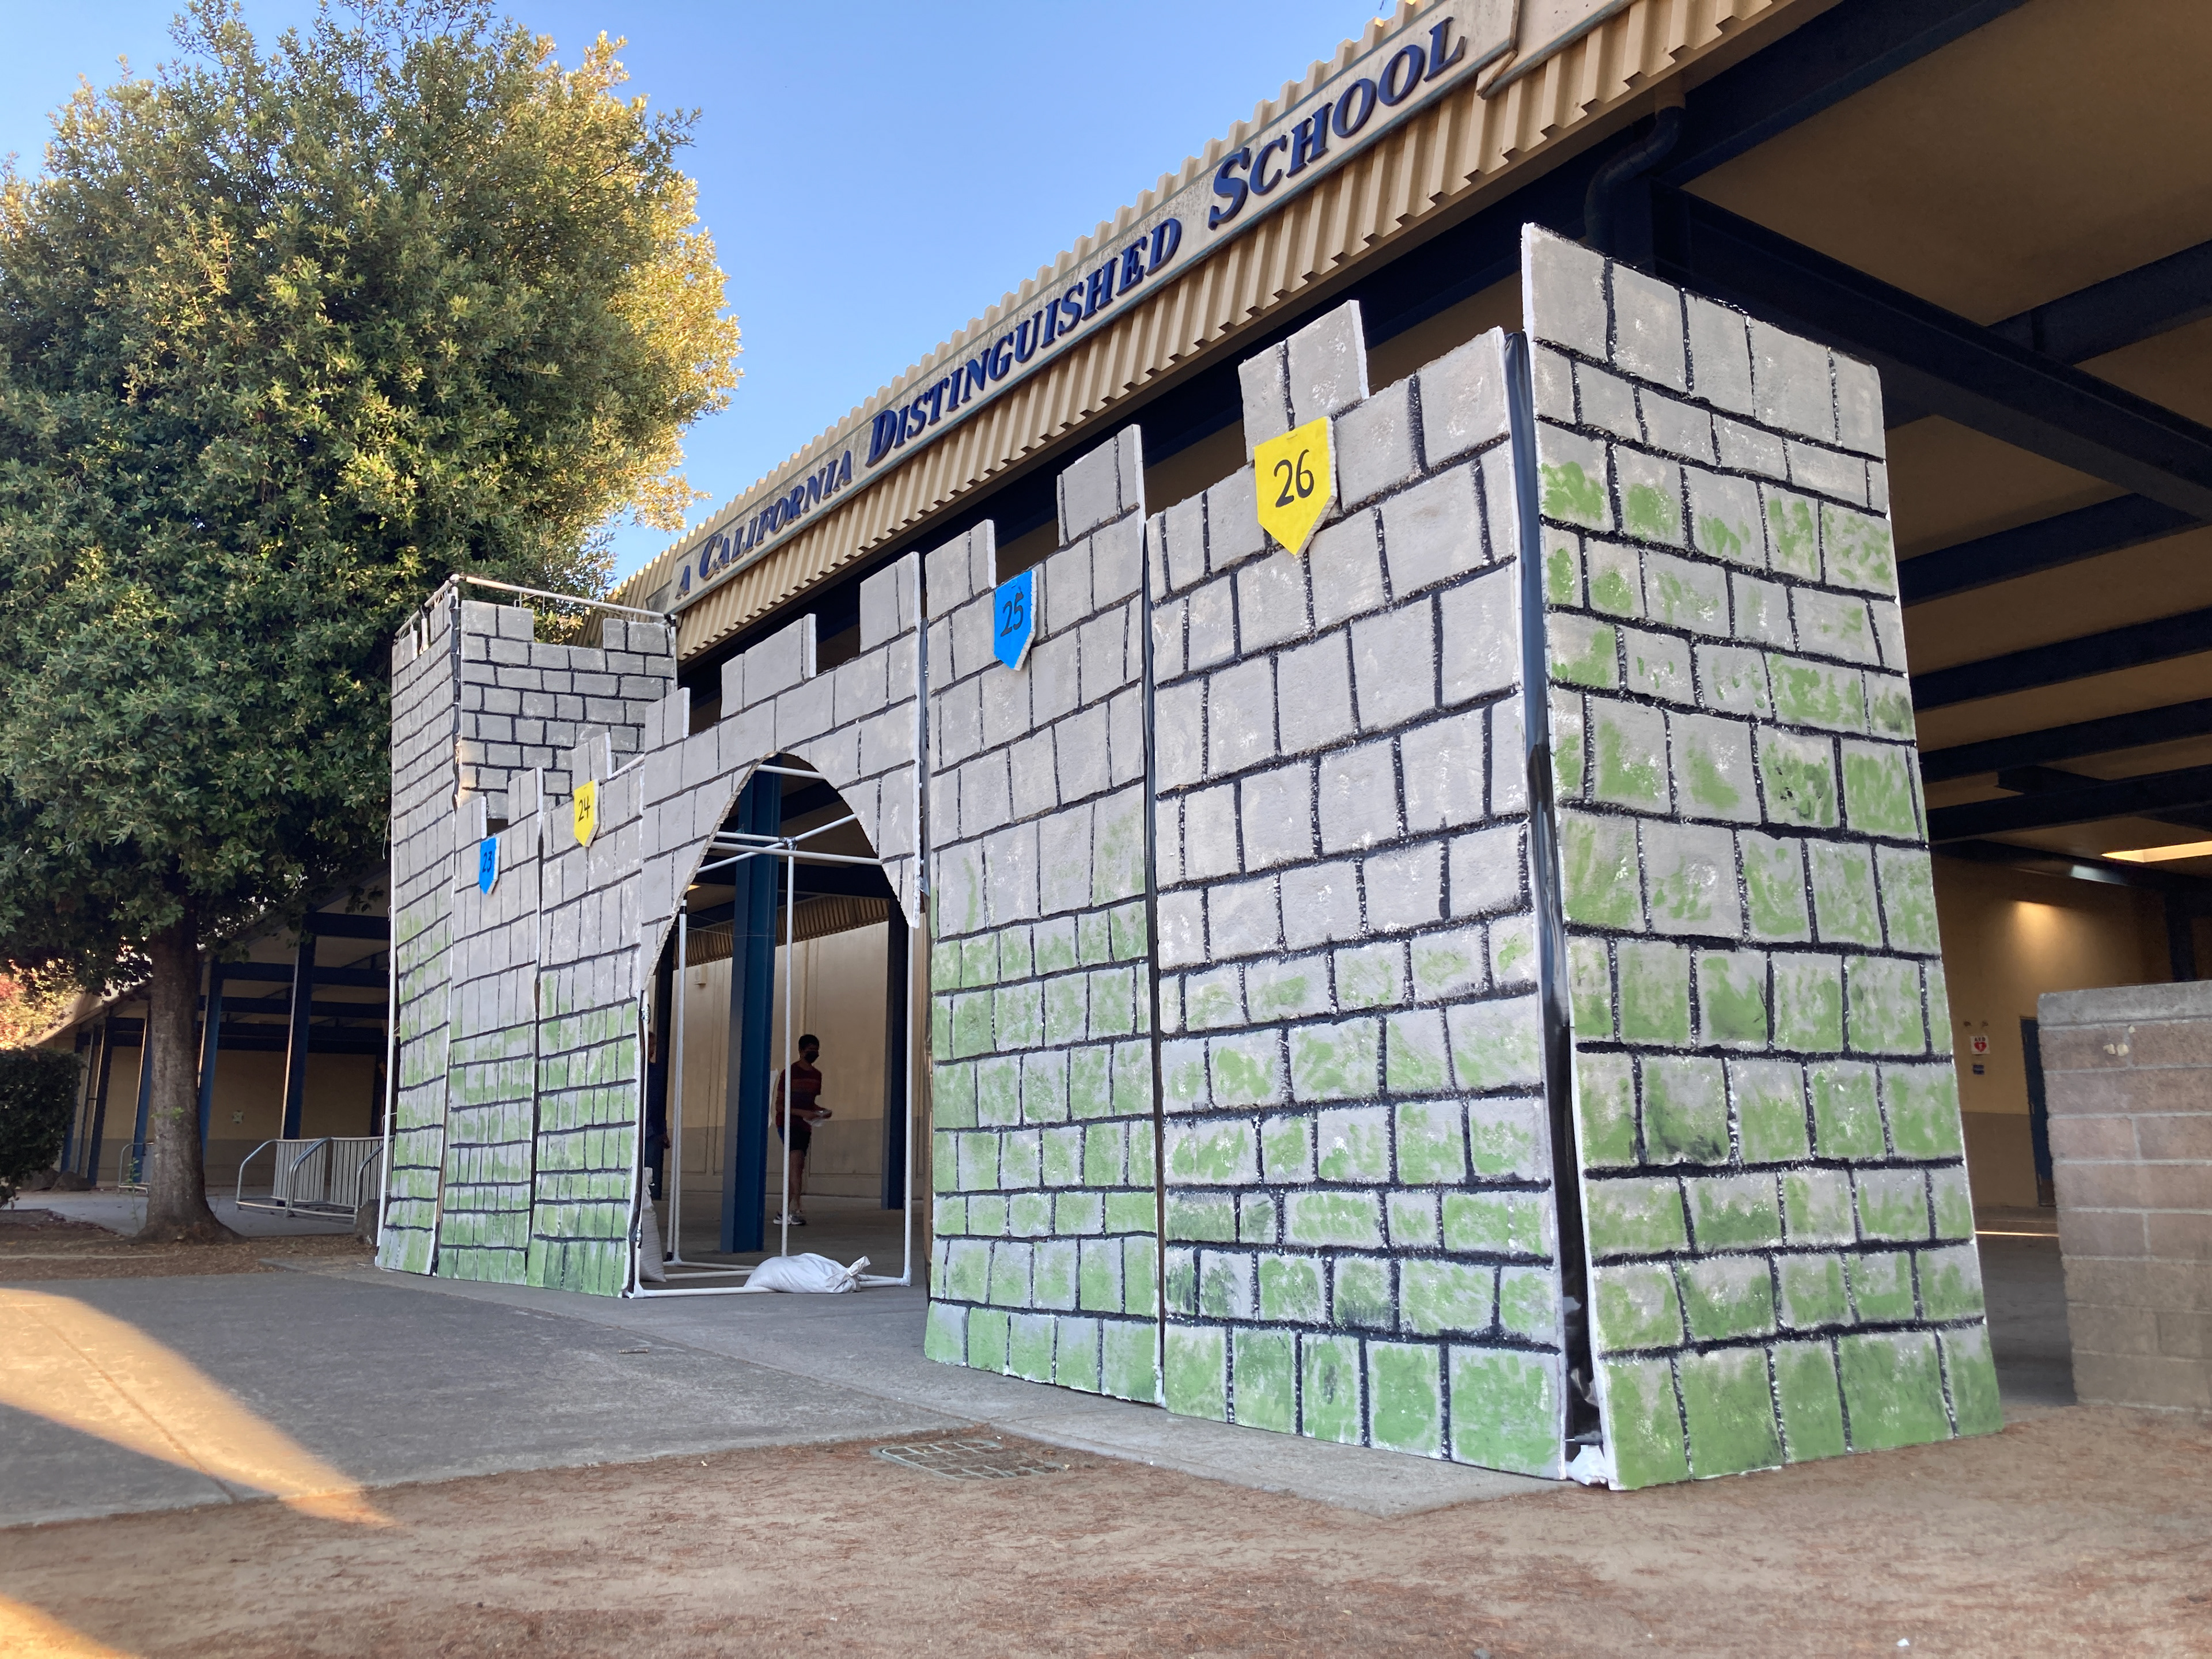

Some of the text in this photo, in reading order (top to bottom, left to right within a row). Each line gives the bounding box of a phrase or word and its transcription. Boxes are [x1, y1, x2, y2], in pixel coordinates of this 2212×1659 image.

[675, 16, 1465, 600] A CALIFORNIA DISTINGUISHED SCHOOL
[1274, 449, 1314, 507] 26
[1001, 592, 1024, 637] 25
[578, 796, 590, 822] 24
[482, 850, 492, 873] 23
